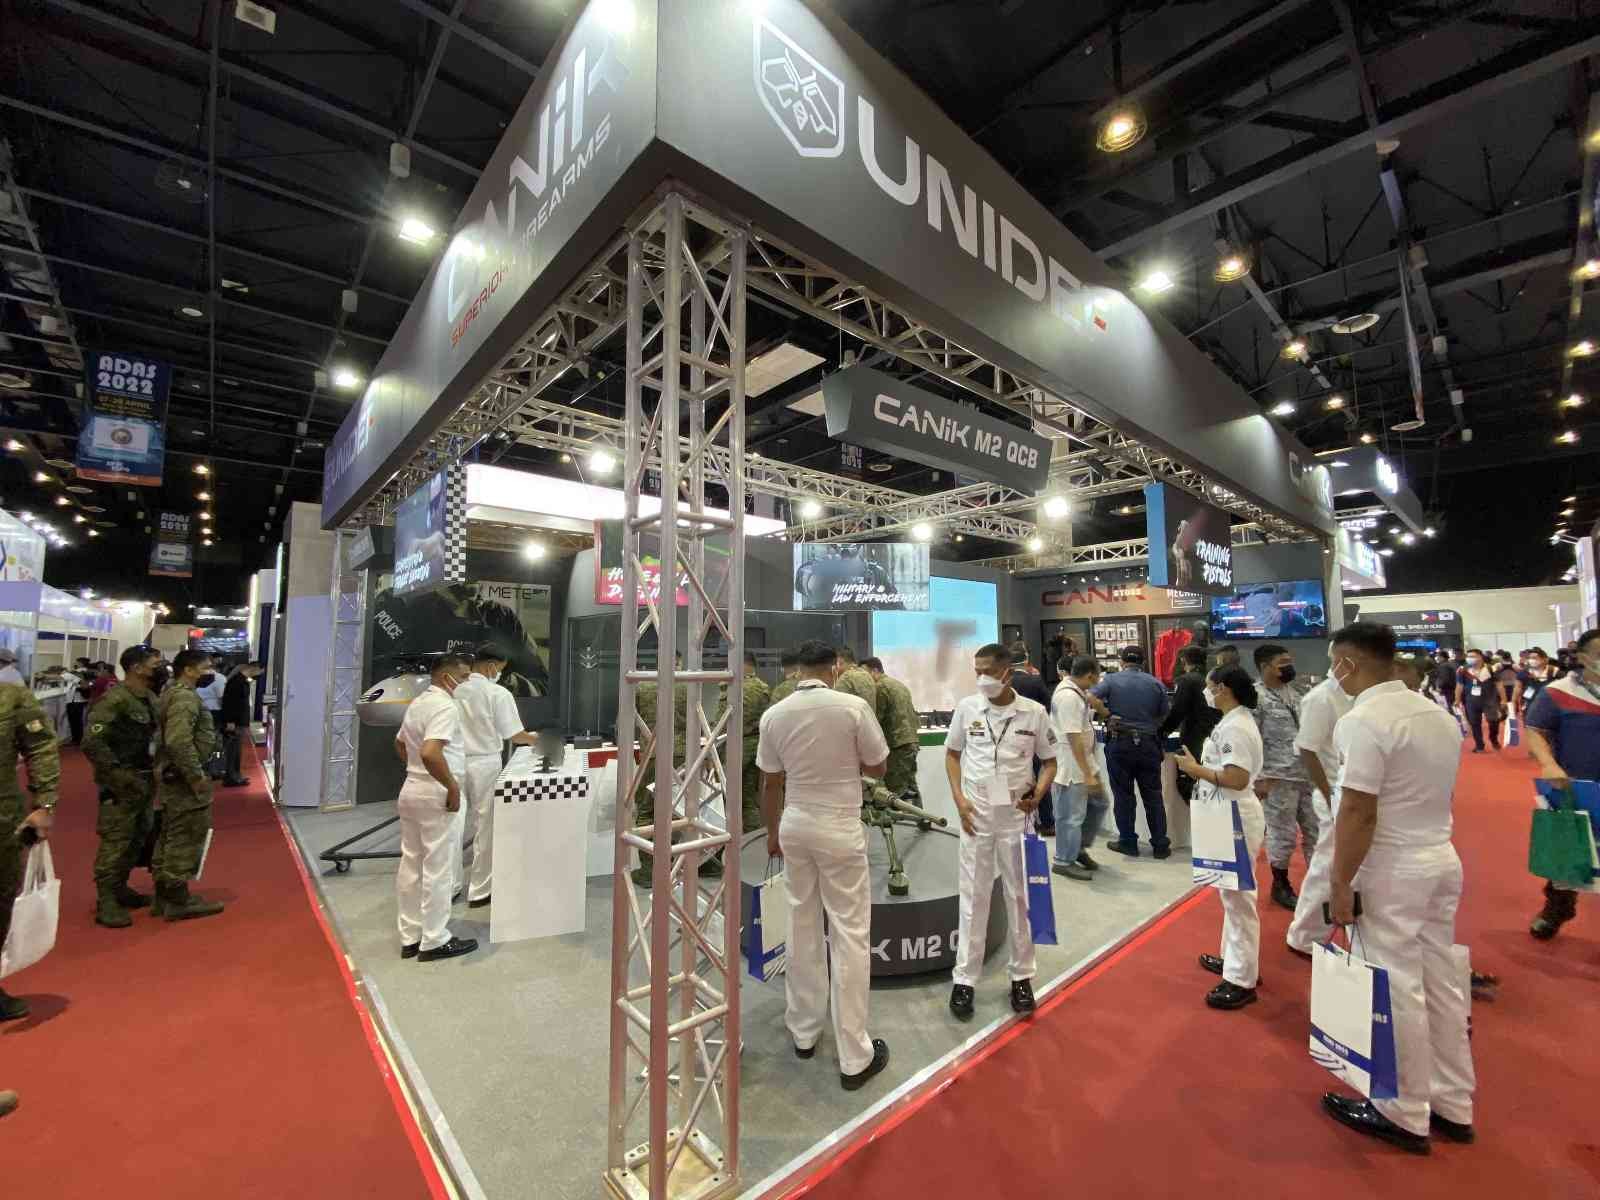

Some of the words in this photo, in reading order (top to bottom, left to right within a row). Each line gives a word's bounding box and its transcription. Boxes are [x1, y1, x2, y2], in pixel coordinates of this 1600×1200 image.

[858, 95, 1098, 340] UNIDE
[451, 262, 510, 347] SUPERIO
[99, 356, 157, 379] ADAS
[97, 371, 153, 395] 2022
[974, 429, 1002, 458] M2
[1006, 441, 1039, 469] QCB
[1196, 539, 1230, 567] TRAINING
[832, 583, 876, 594] MILITARY
[374, 609, 403, 640] POLICE
[901, 935, 942, 961] M2
